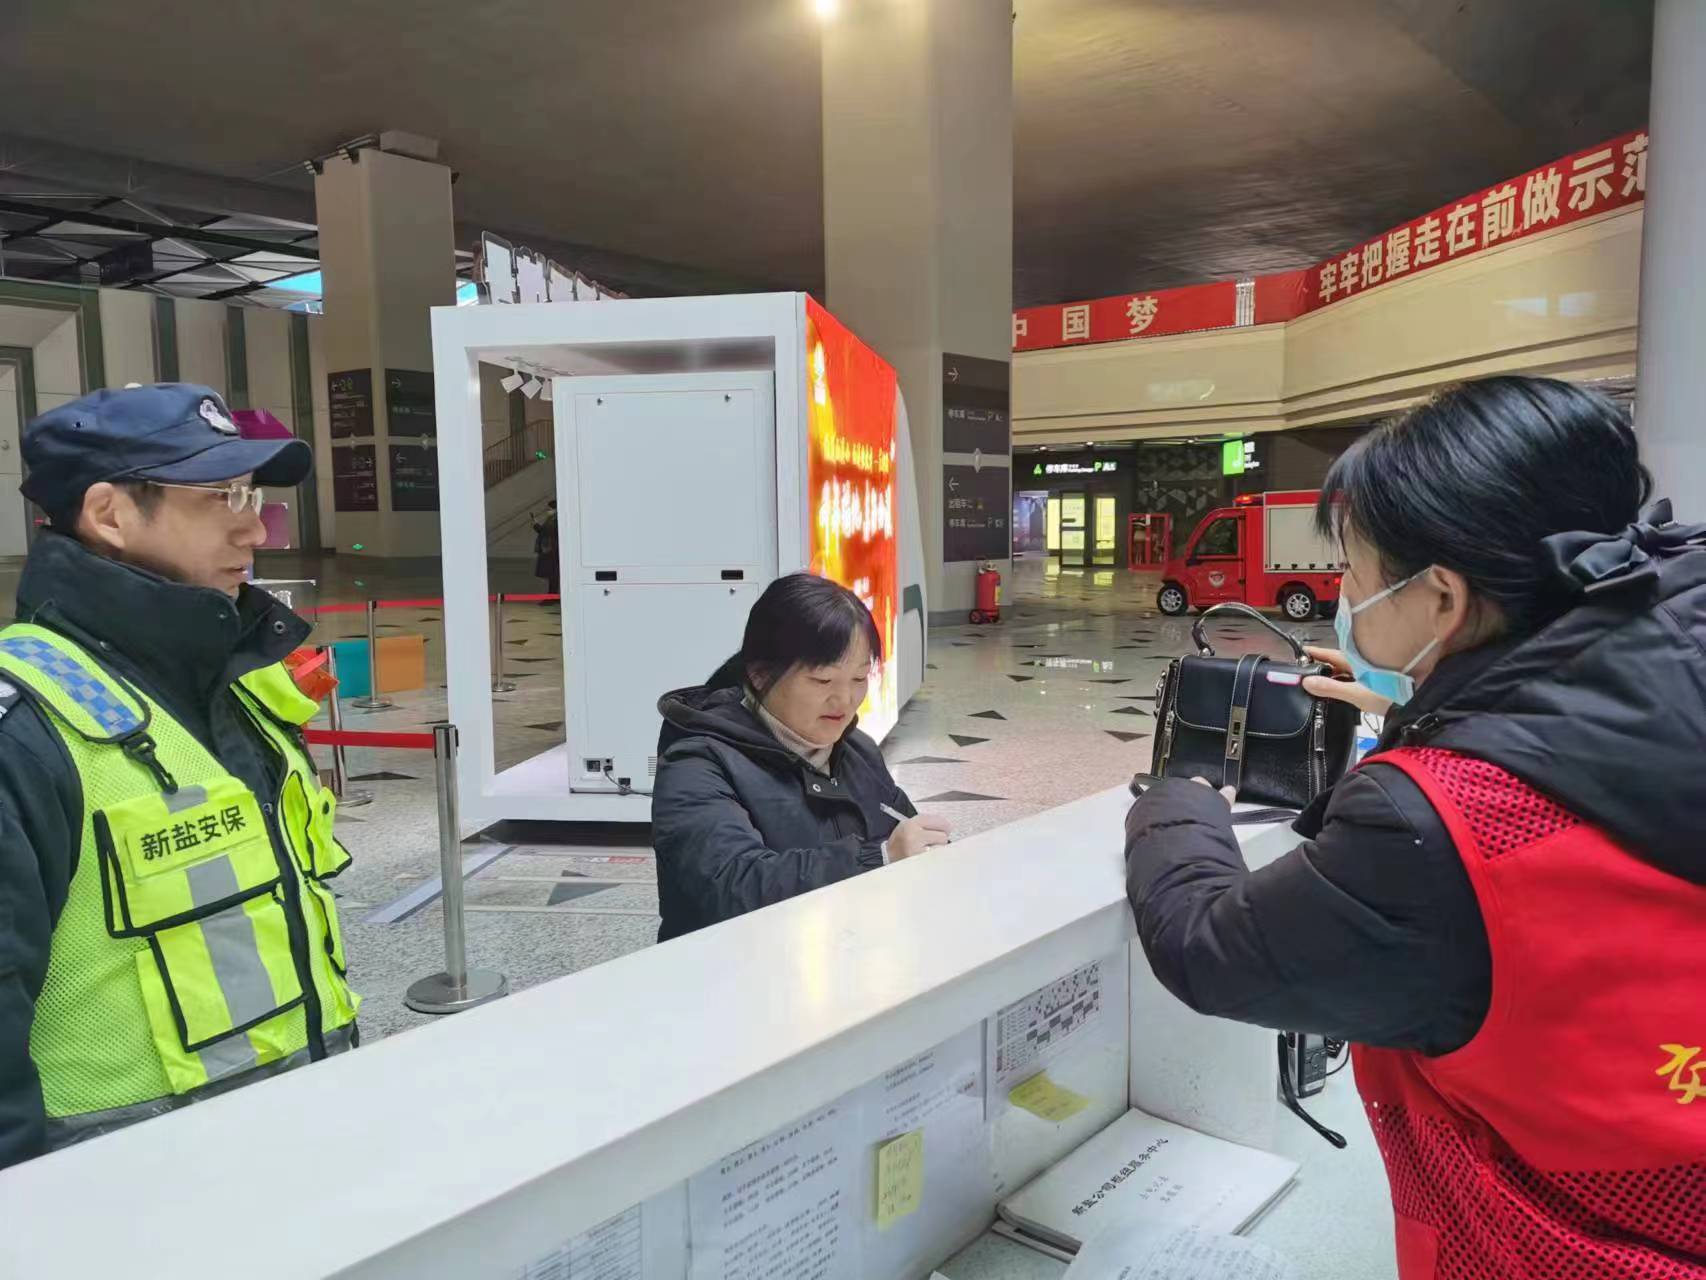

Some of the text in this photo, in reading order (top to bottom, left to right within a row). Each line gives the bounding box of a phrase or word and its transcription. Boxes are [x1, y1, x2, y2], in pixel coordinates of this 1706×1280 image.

[1319, 133, 1649, 302] 牢牢把握走在前做示范
[140, 805, 246, 861] 新盐安保
